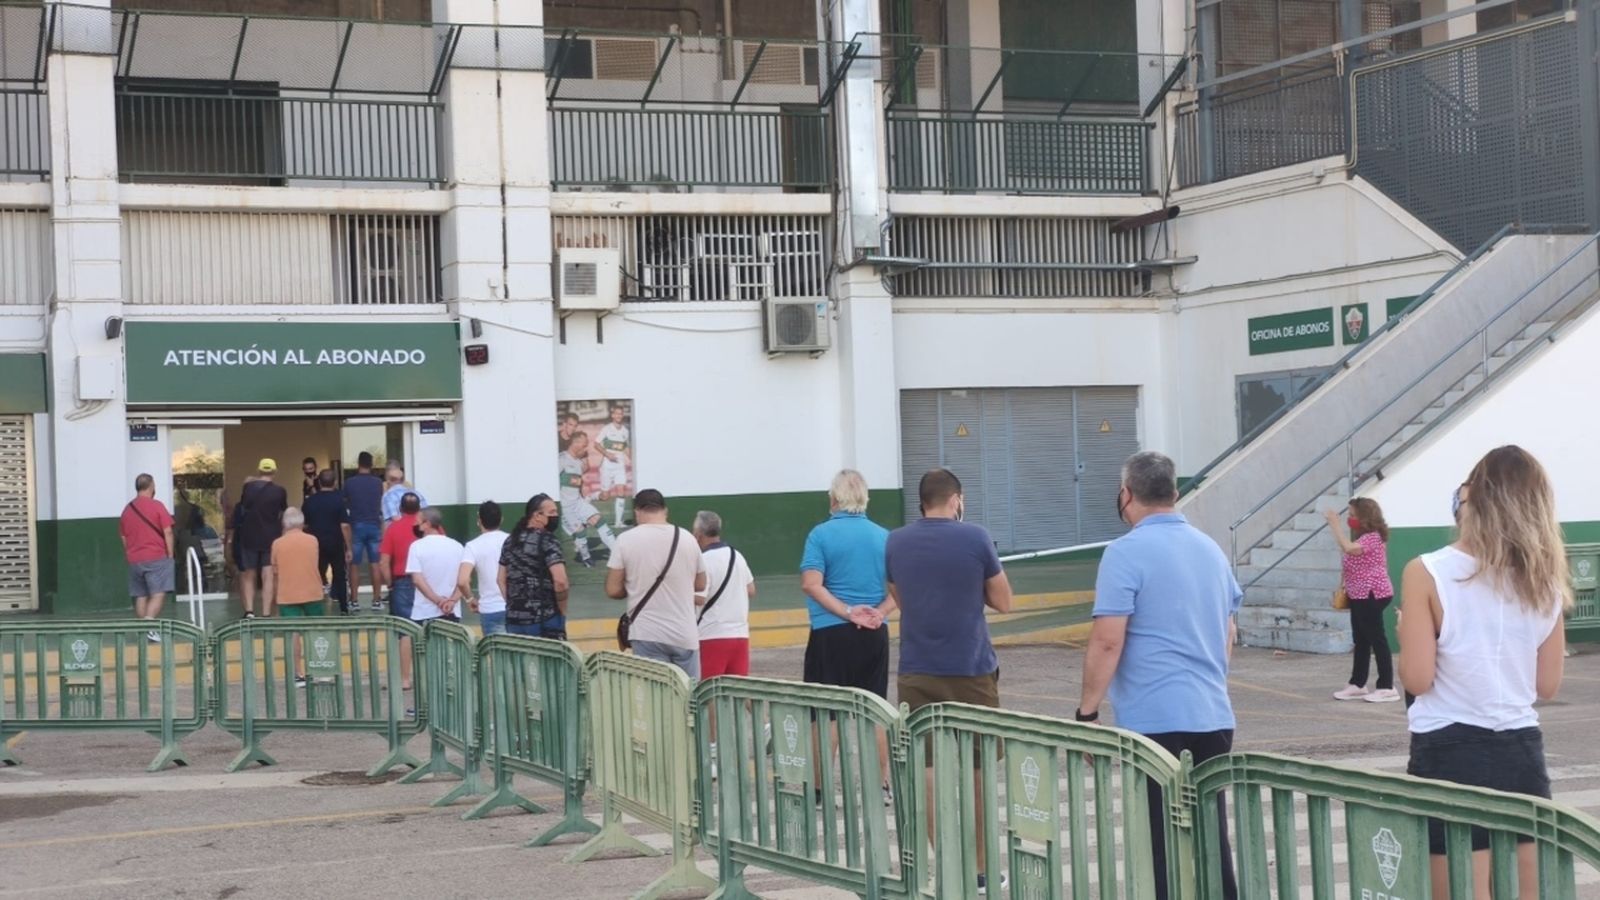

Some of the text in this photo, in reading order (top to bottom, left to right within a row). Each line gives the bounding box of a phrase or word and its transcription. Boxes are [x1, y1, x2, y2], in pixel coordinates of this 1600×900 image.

[1251, 321, 1330, 341] OFICINA DE ABONOS
[163, 343, 426, 365] ATENCIÓN AL ABONADO
